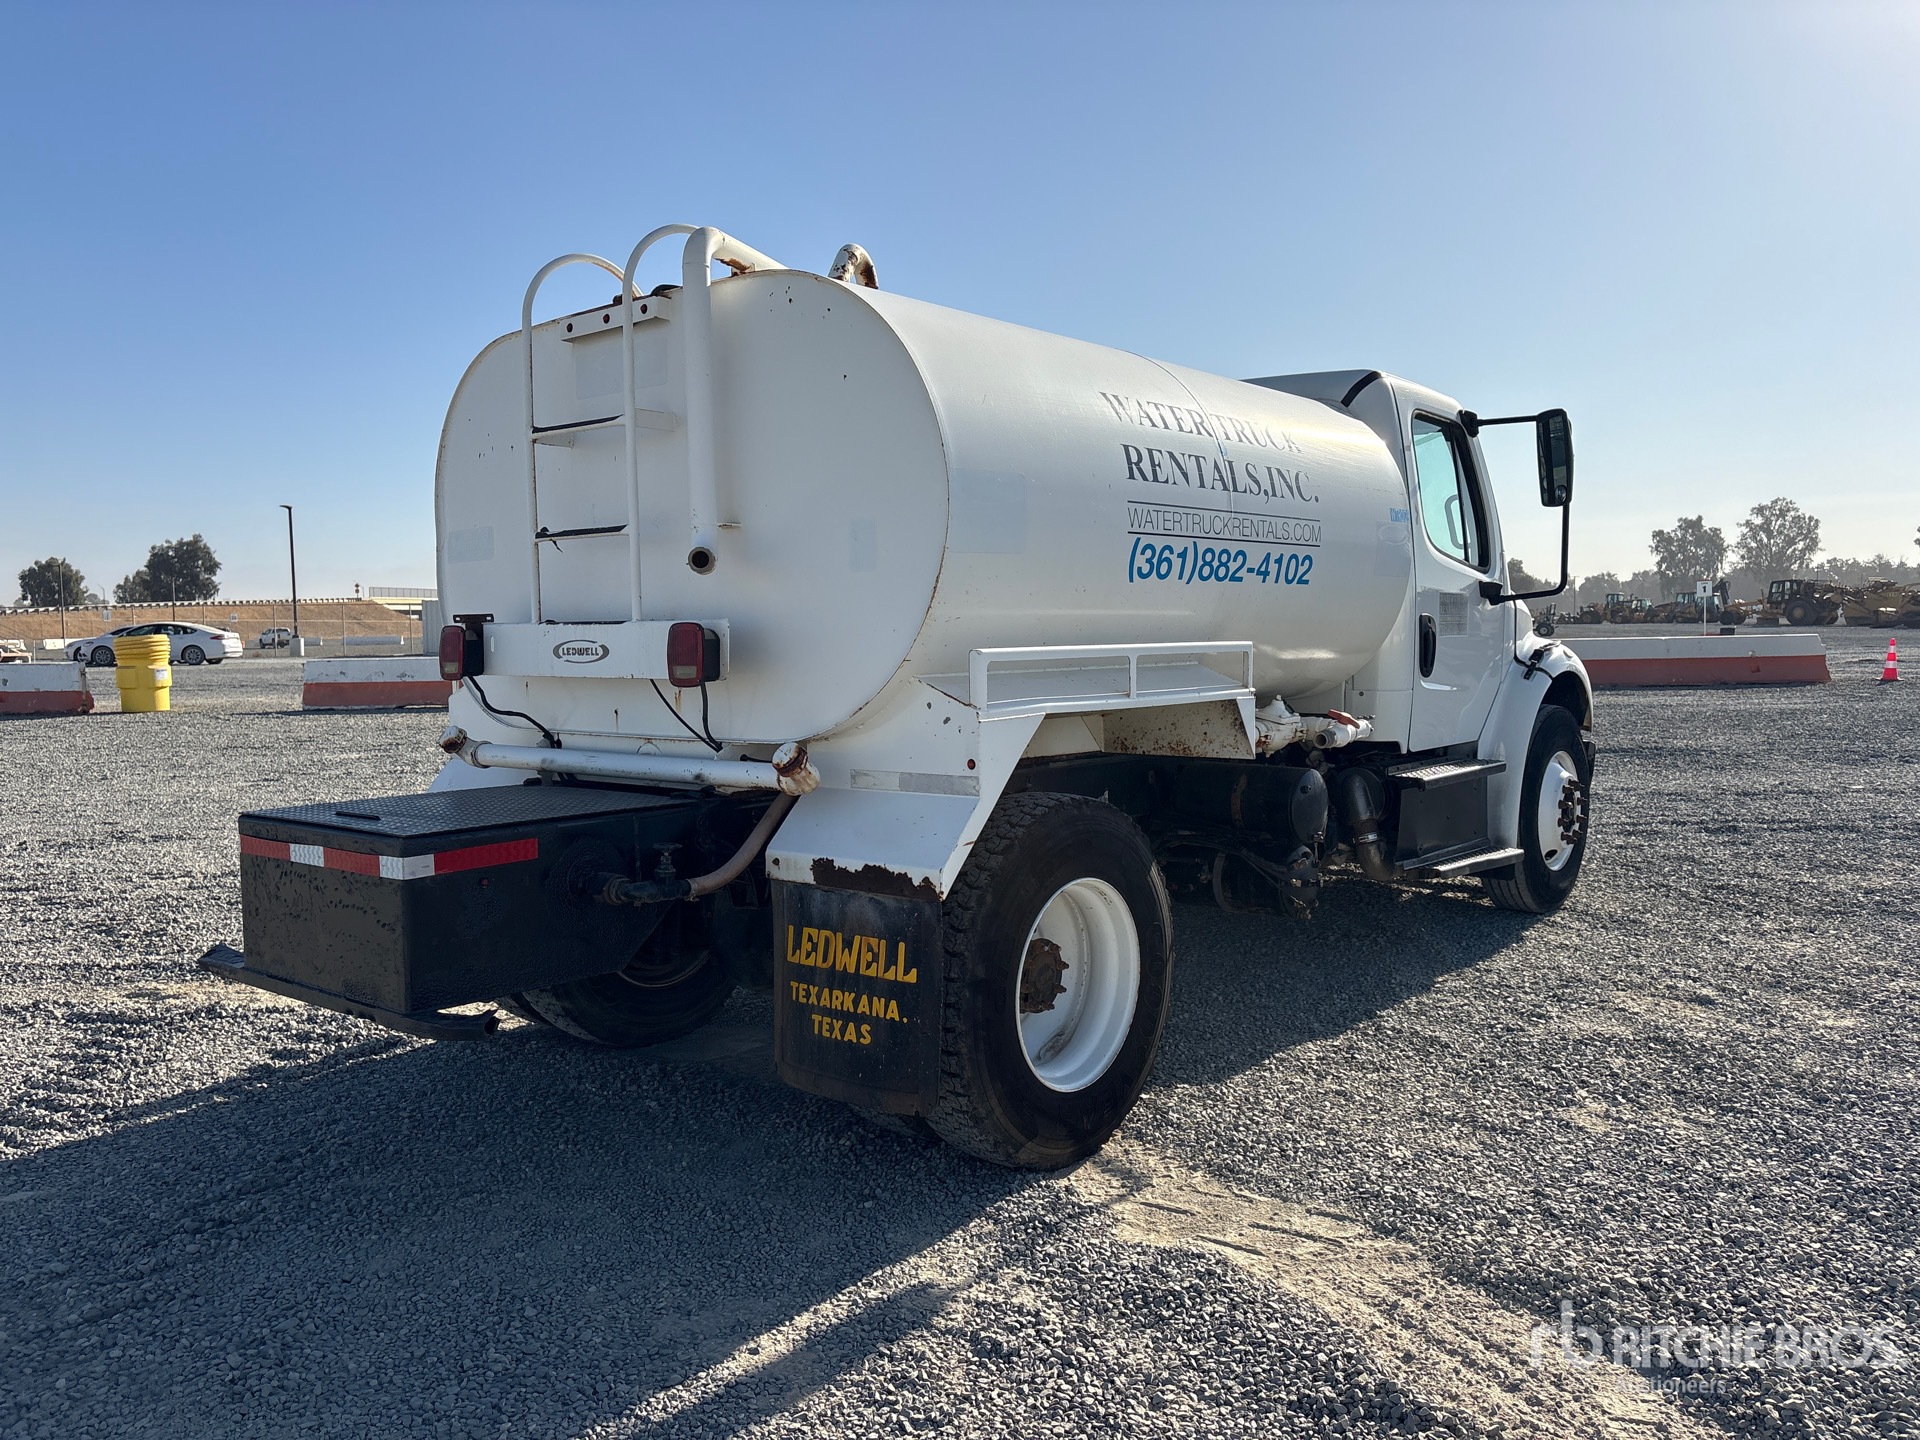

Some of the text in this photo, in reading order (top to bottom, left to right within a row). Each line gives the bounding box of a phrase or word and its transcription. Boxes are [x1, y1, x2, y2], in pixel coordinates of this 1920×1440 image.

[1099, 391, 1303, 454] WATER TRUCK
[1127, 507, 1321, 543] WATERTRUCKRENTALS.COM
[1127, 537, 1313, 585] (361)882-4102
[562, 647, 600, 656] LEDWELL
[786, 924, 918, 984] LEDWELL
[811, 1013, 873, 1045] TEXAS
